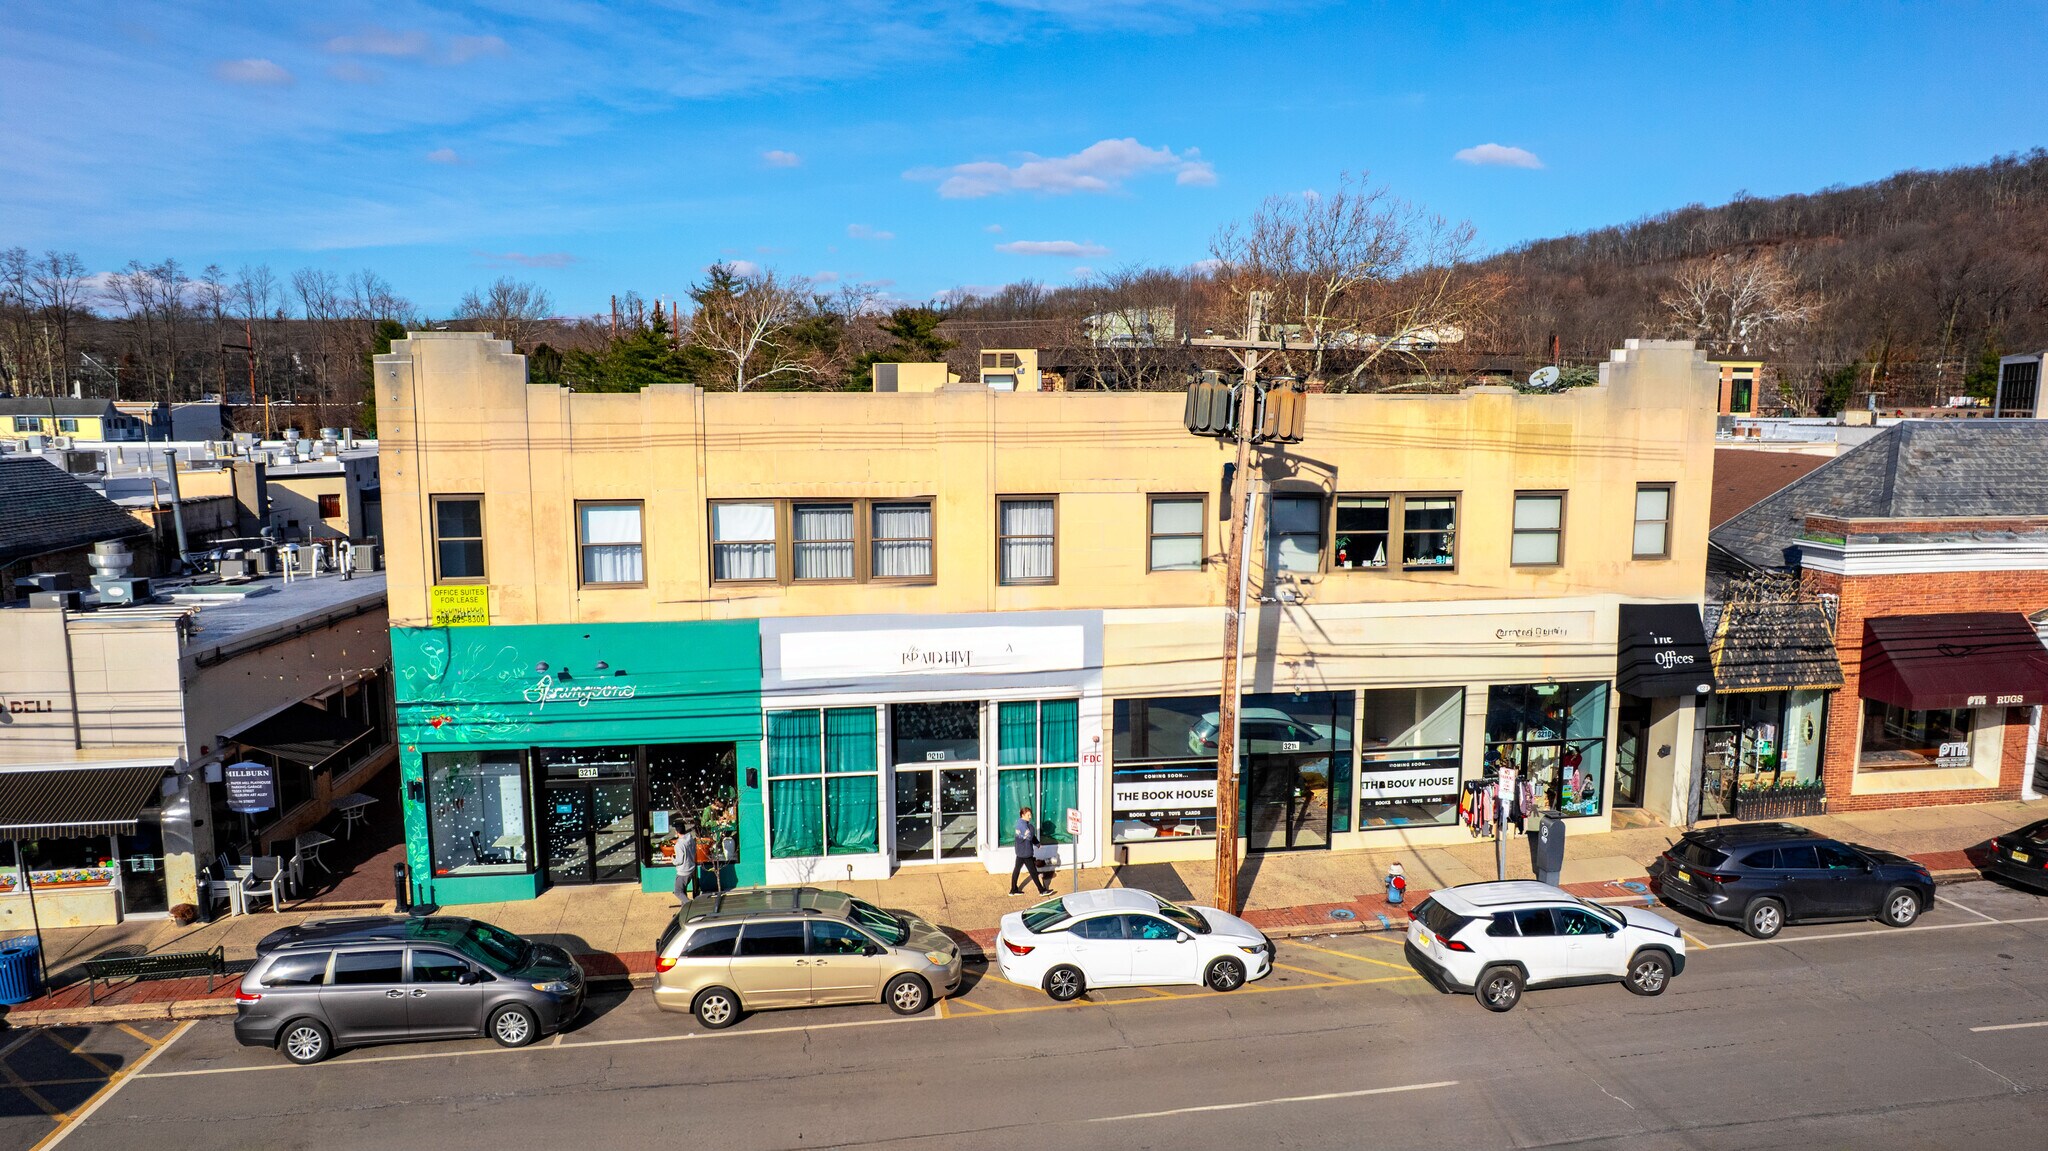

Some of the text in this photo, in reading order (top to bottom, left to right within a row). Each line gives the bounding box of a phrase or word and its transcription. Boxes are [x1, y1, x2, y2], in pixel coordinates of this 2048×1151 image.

[434, 588, 485, 597] OFFICE SUITES
[440, 596, 479, 604] FOR LEASE
[1655, 650, 1695, 669] Offices
[1996, 694, 2024, 704] RUGS
[10, 700, 53, 713] DELI
[1083, 754, 1102, 763] FDC
[225, 769, 270, 777] MILLBURN
[580, 768, 598, 777] 321A
[1418, 776, 1455, 787] HOUSE
[1116, 789, 1214, 801] THE BOOK HOUSE
